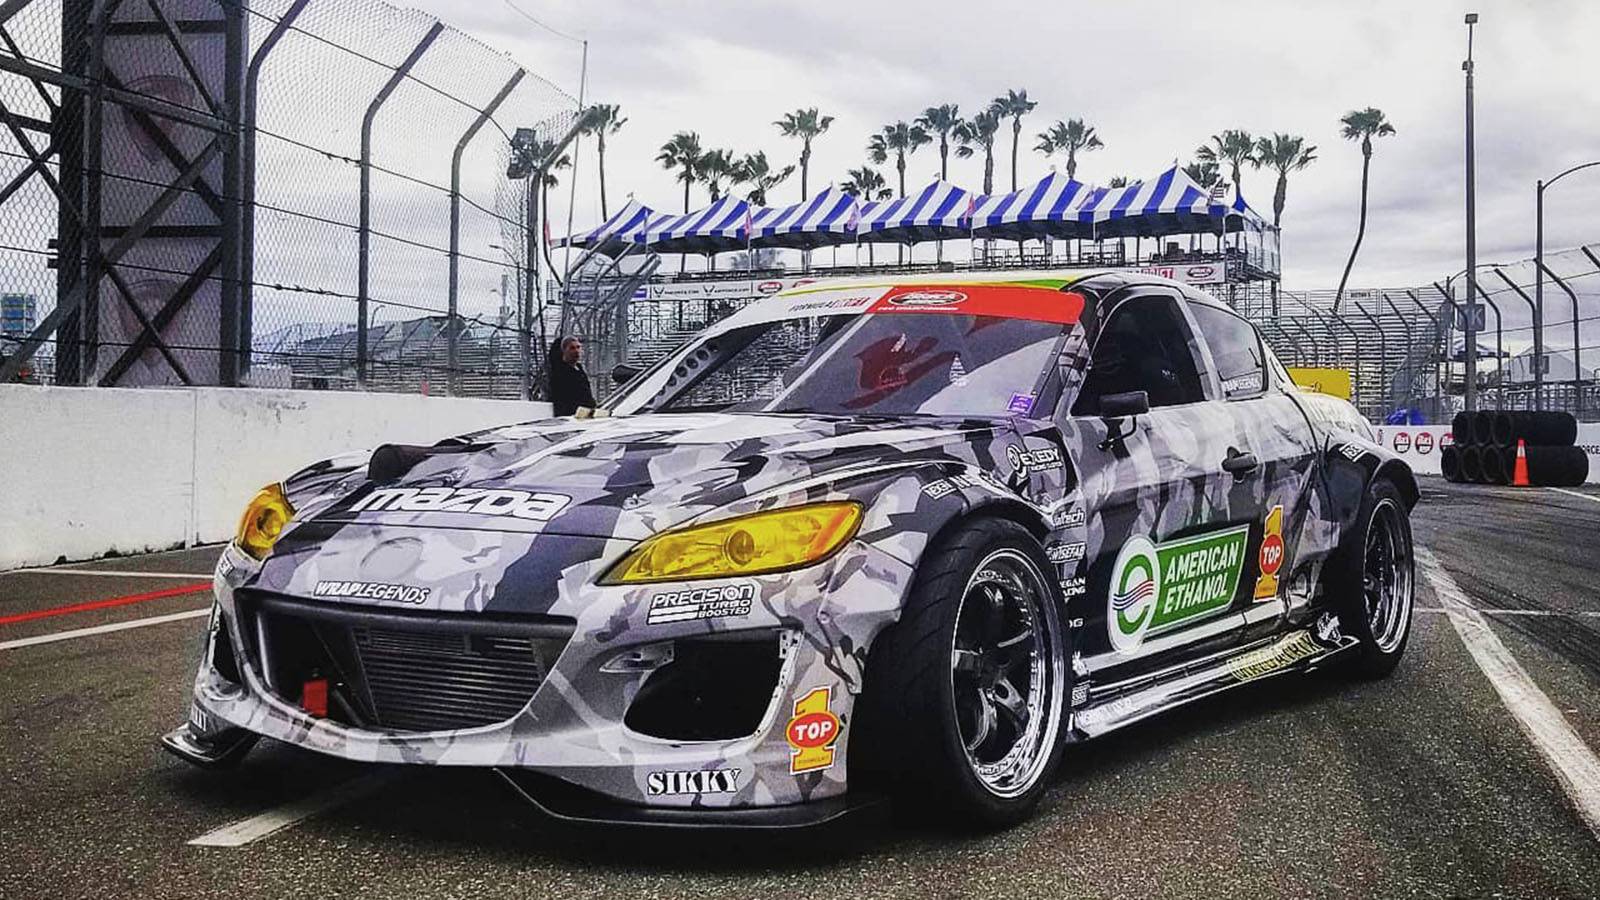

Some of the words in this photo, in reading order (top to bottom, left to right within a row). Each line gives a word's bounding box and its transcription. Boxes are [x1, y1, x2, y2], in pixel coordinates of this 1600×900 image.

[1020, 448, 1061, 465] EXEDY
[1580, 445, 1600, 455] ORCE
[1164, 541, 1240, 585] AMERICAN
[1263, 545, 1281, 565] TOP
[1059, 577, 1086, 588] EGAN
[1063, 586, 1086, 597] CING
[651, 585, 754, 608] PRECISION
[1162, 572, 1228, 615] ETHANOL
[698, 606, 750, 618] BOOSTED
[701, 599, 751, 611] TURBO
[794, 720, 833, 741] TOP
[647, 769, 741, 795] SIKKY
